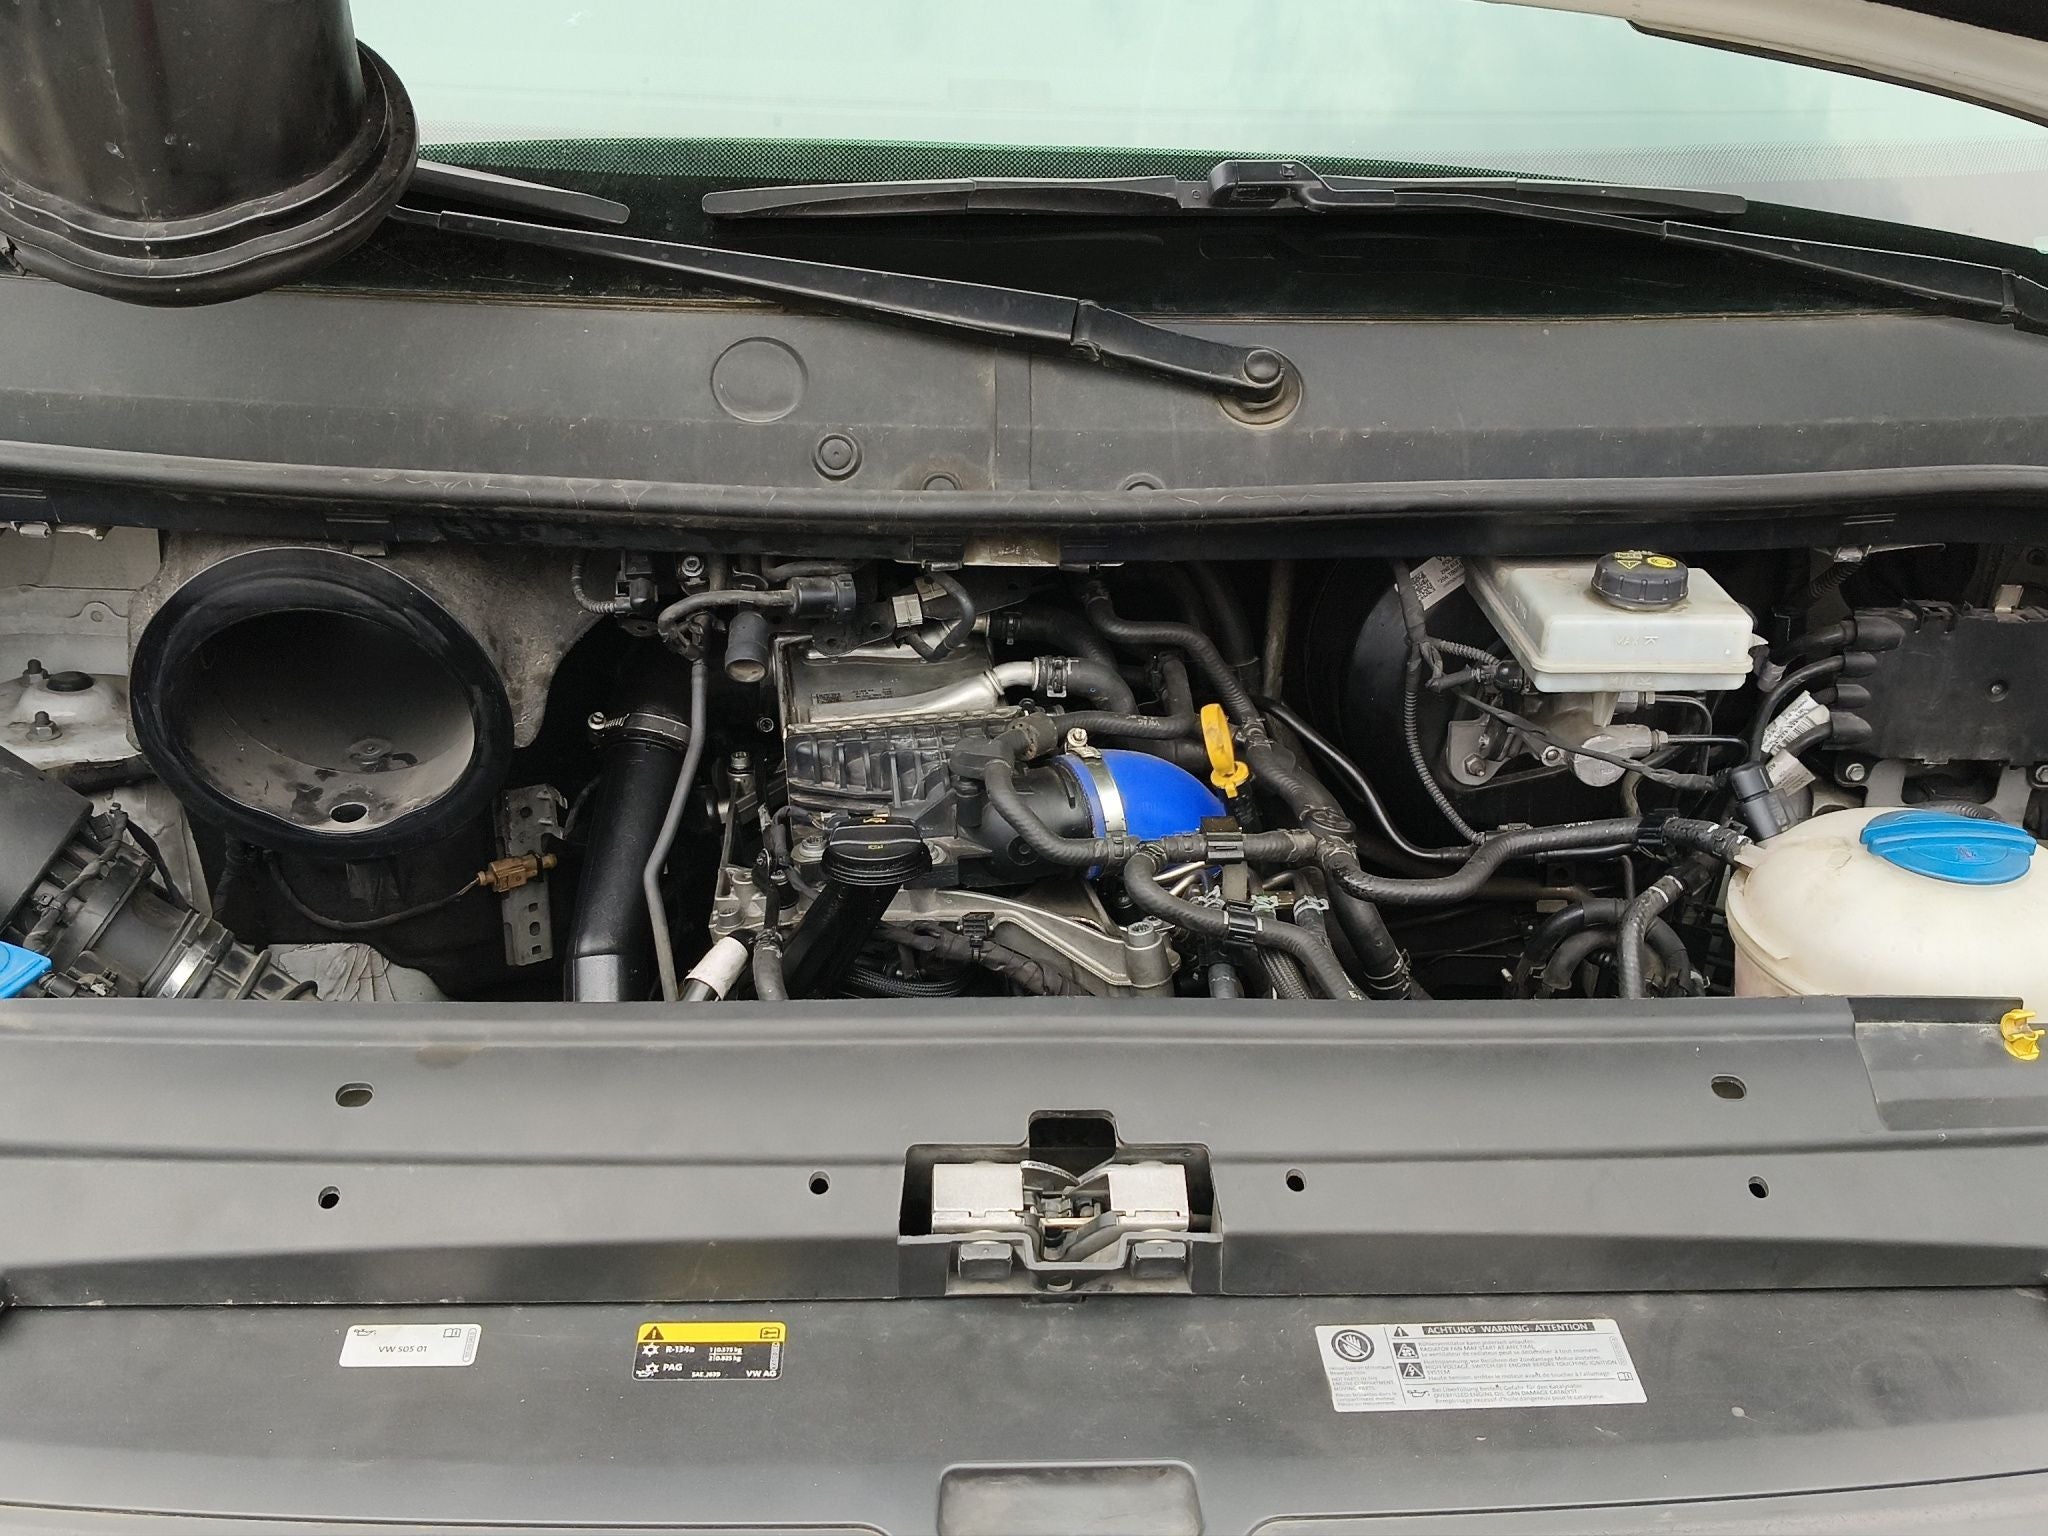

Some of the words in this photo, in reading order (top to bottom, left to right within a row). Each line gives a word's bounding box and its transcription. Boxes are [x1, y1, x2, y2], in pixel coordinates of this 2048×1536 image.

[1427, 1325, 1476, 1334] ACHTUNG
[1480, 1324, 1530, 1333] WARNING
[1535, 1323, 1588, 1332] ATTENTION
[378, 1345, 396, 1353] VW
[398, 1345, 414, 1353] 505
[665, 1345, 696, 1353] R-134a
[662, 1363, 683, 1371] PAG
[746, 1369, 762, 1377] VW
[763, 1369, 777, 1377] AG
